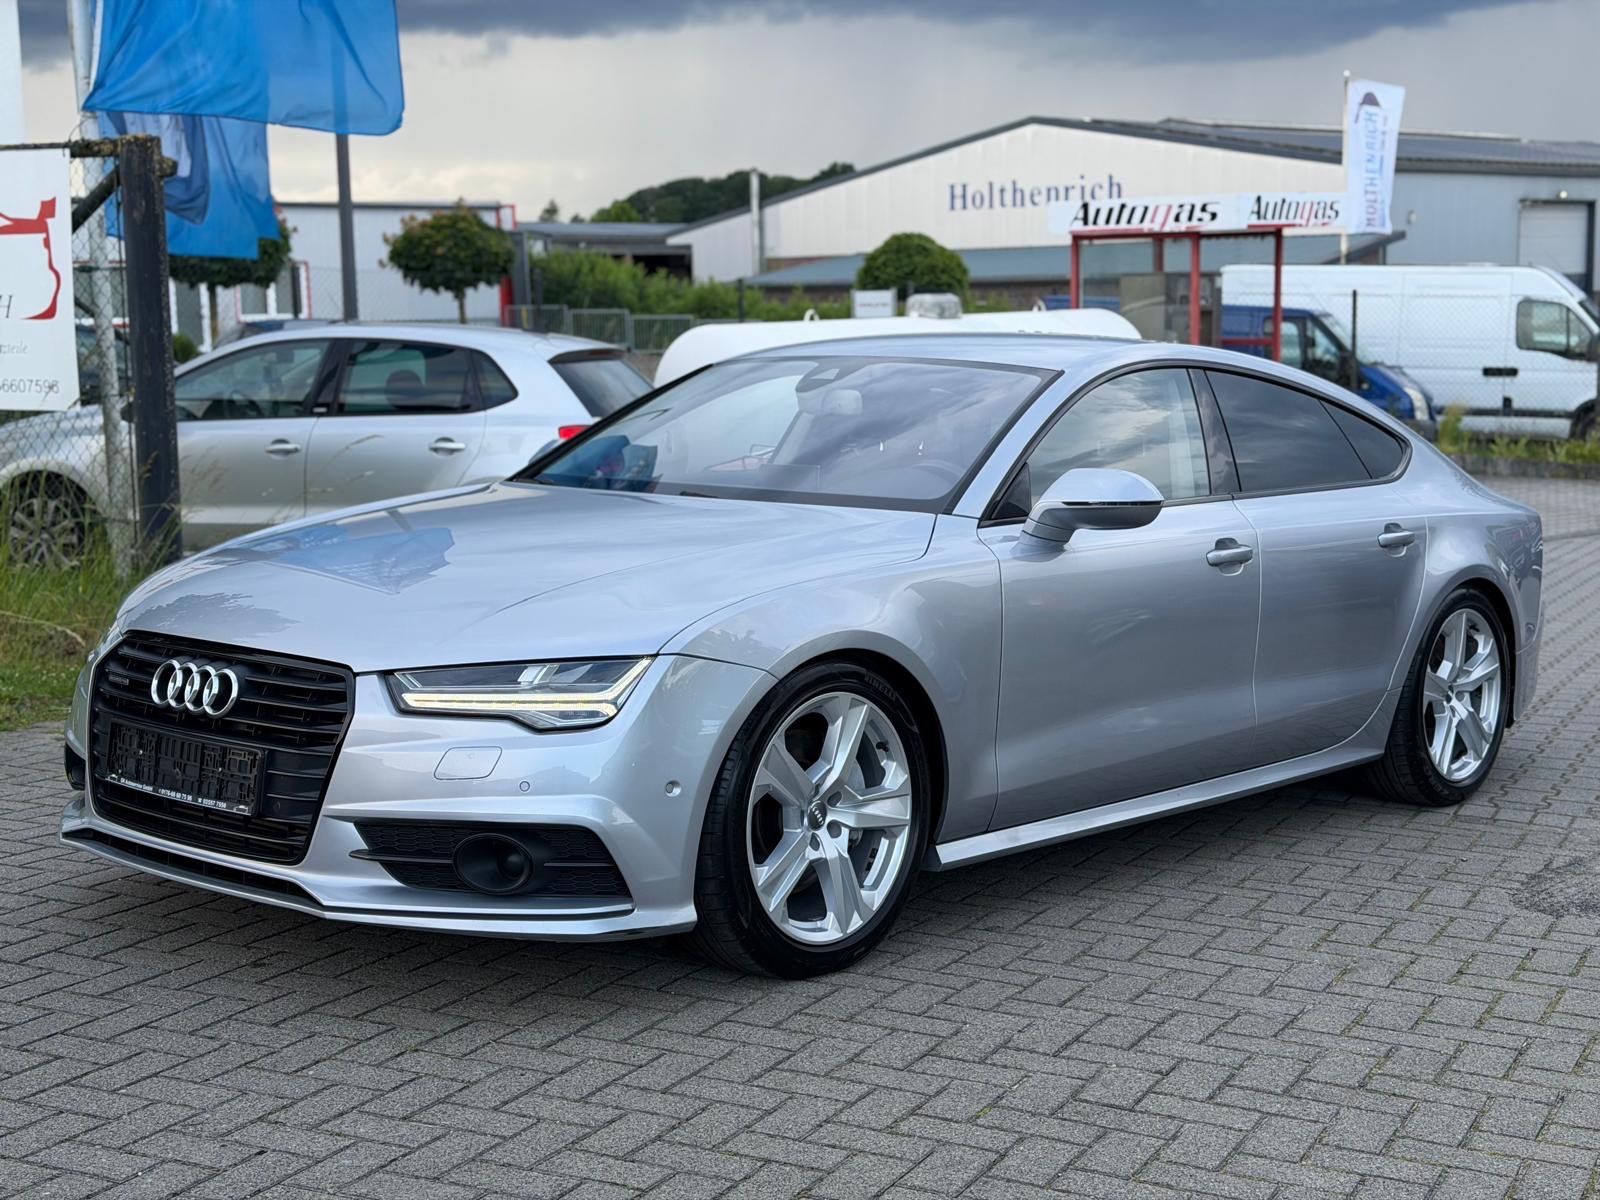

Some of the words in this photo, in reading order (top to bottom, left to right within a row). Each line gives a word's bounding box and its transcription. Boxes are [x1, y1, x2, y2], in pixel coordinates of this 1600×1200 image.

[948, 174, 1123, 212] Holthenrich
[1070, 200, 1221, 230] Autogas
[1248, 195, 1341, 227] Autogas
